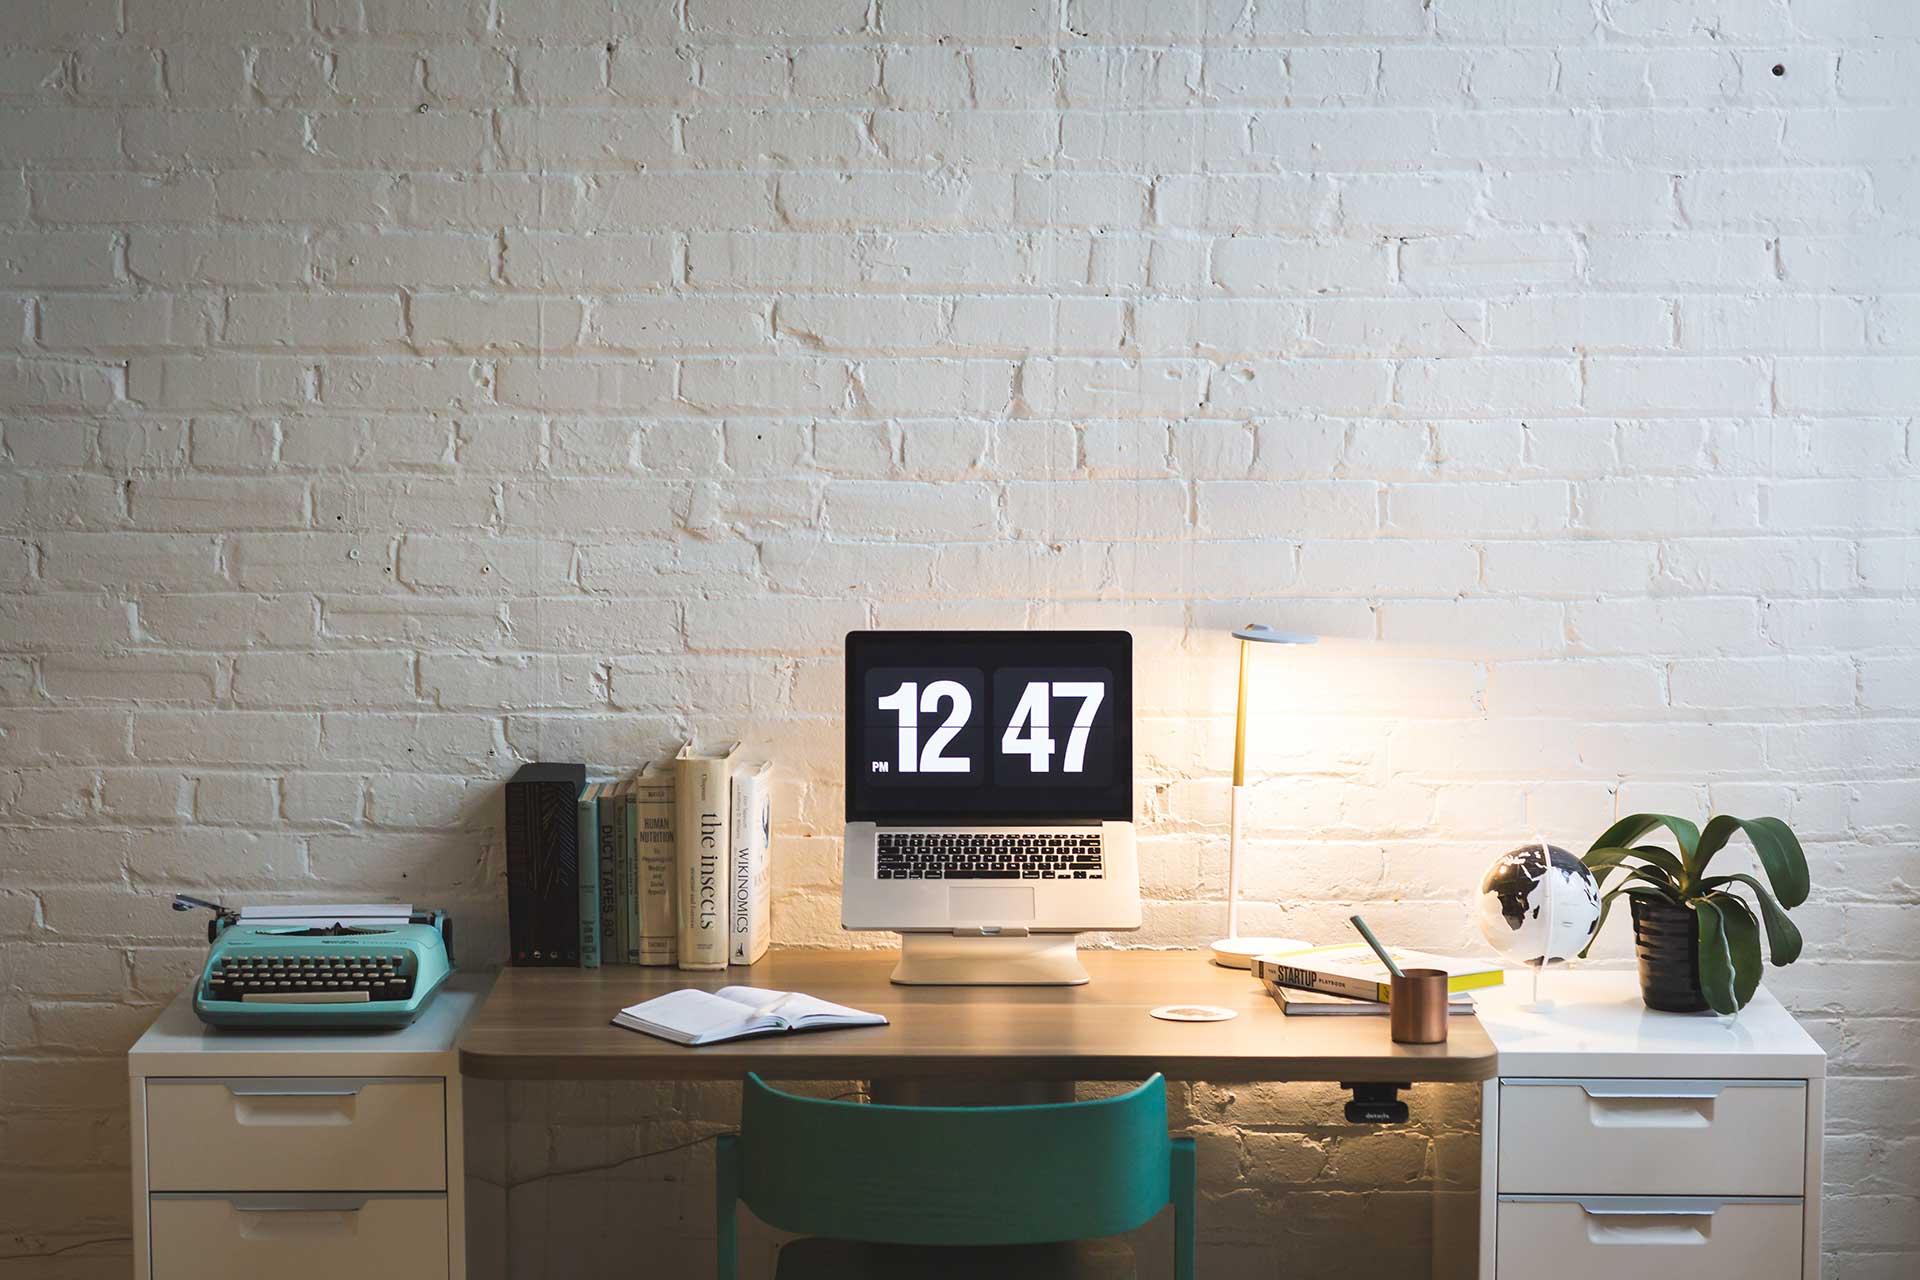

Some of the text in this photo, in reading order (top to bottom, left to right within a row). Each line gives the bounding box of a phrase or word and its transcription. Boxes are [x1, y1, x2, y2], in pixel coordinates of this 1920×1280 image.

[878, 680, 1105, 773] 12 47
[872, 761, 889, 773] PM
[639, 831, 674, 843] NUTRITION
[644, 817, 670, 830] HUMAN
[701, 812, 722, 848] the
[601, 824, 614, 866] DUCT
[602, 870, 614, 914] TAPES
[700, 855, 719, 930] insects
[736, 847, 750, 934] WIKINOMICS
[1278, 965, 1317, 988] STARTUP
[1318, 978, 1346, 989] PLAYBOOK
